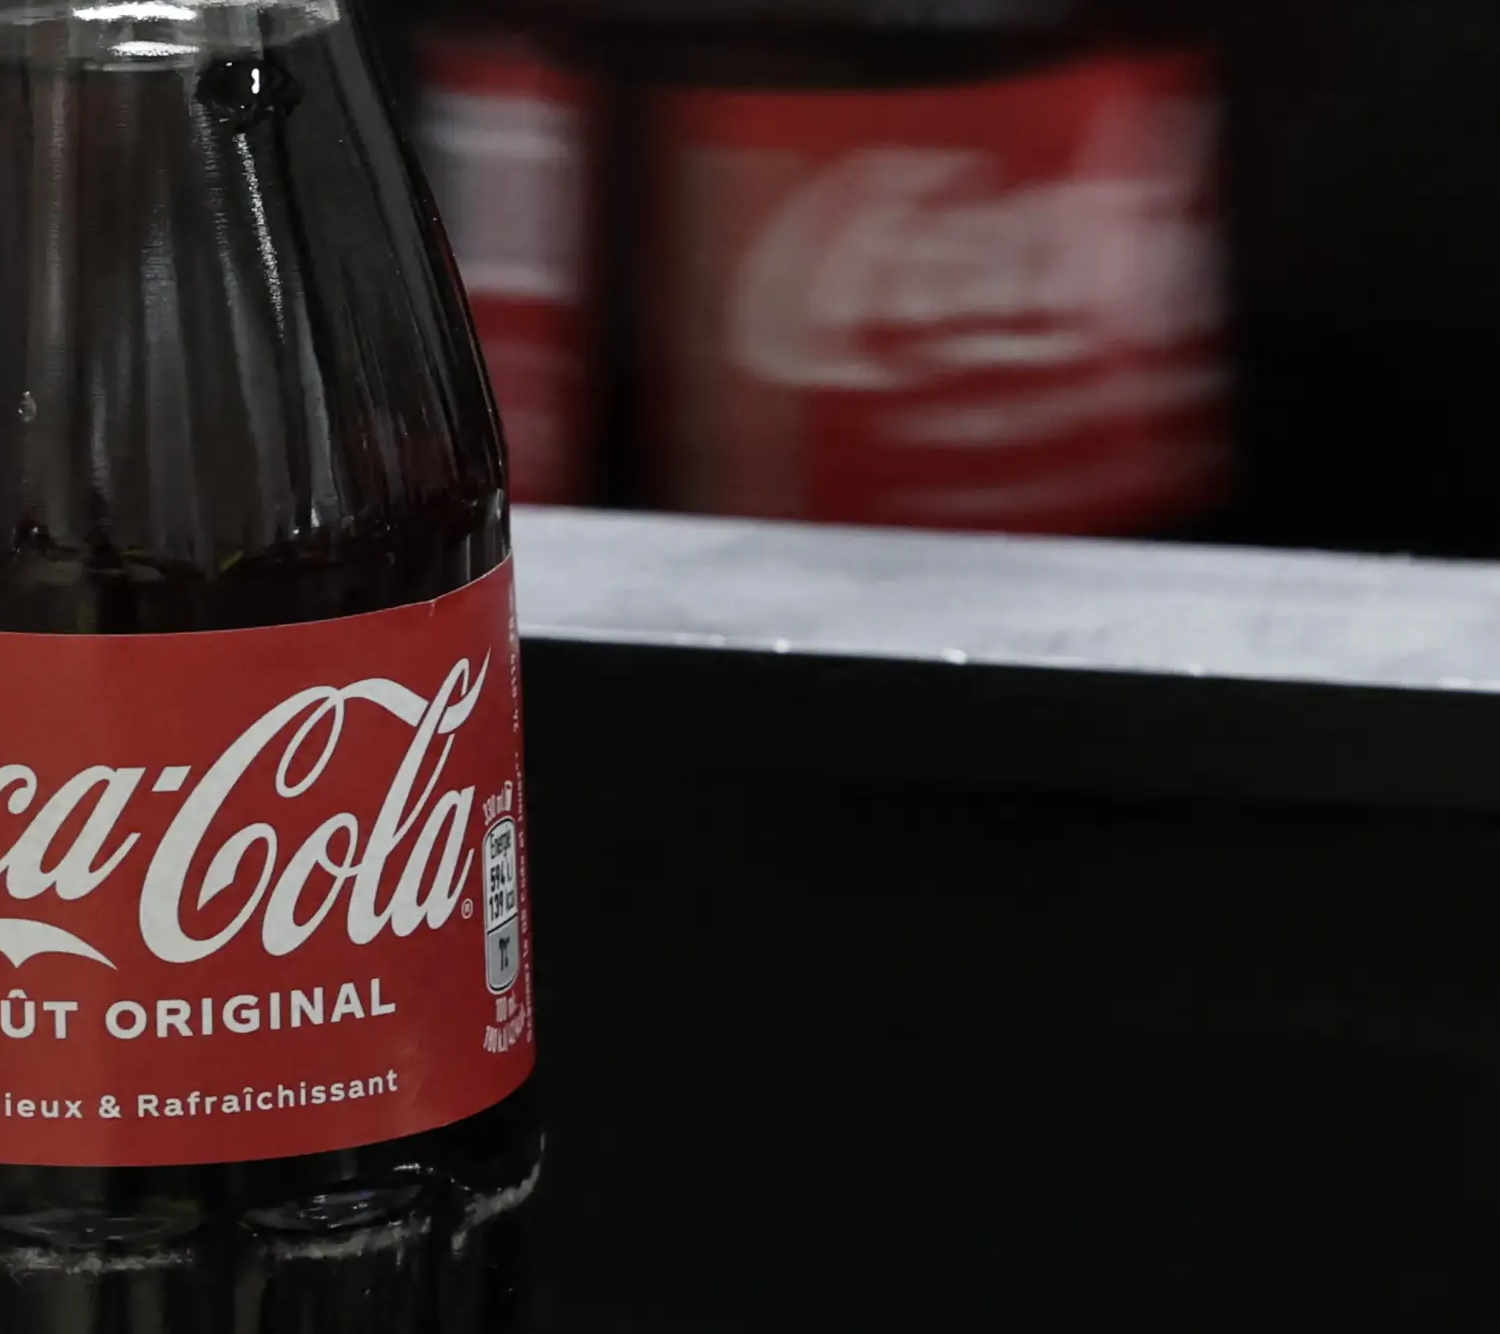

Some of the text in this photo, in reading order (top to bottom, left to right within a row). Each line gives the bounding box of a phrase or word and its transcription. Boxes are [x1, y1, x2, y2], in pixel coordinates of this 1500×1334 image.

[104, 977, 397, 1039] ORIGINAL
[97, 1093, 122, 1119] &
[137, 1068, 399, 1118] Rafraîchissant
